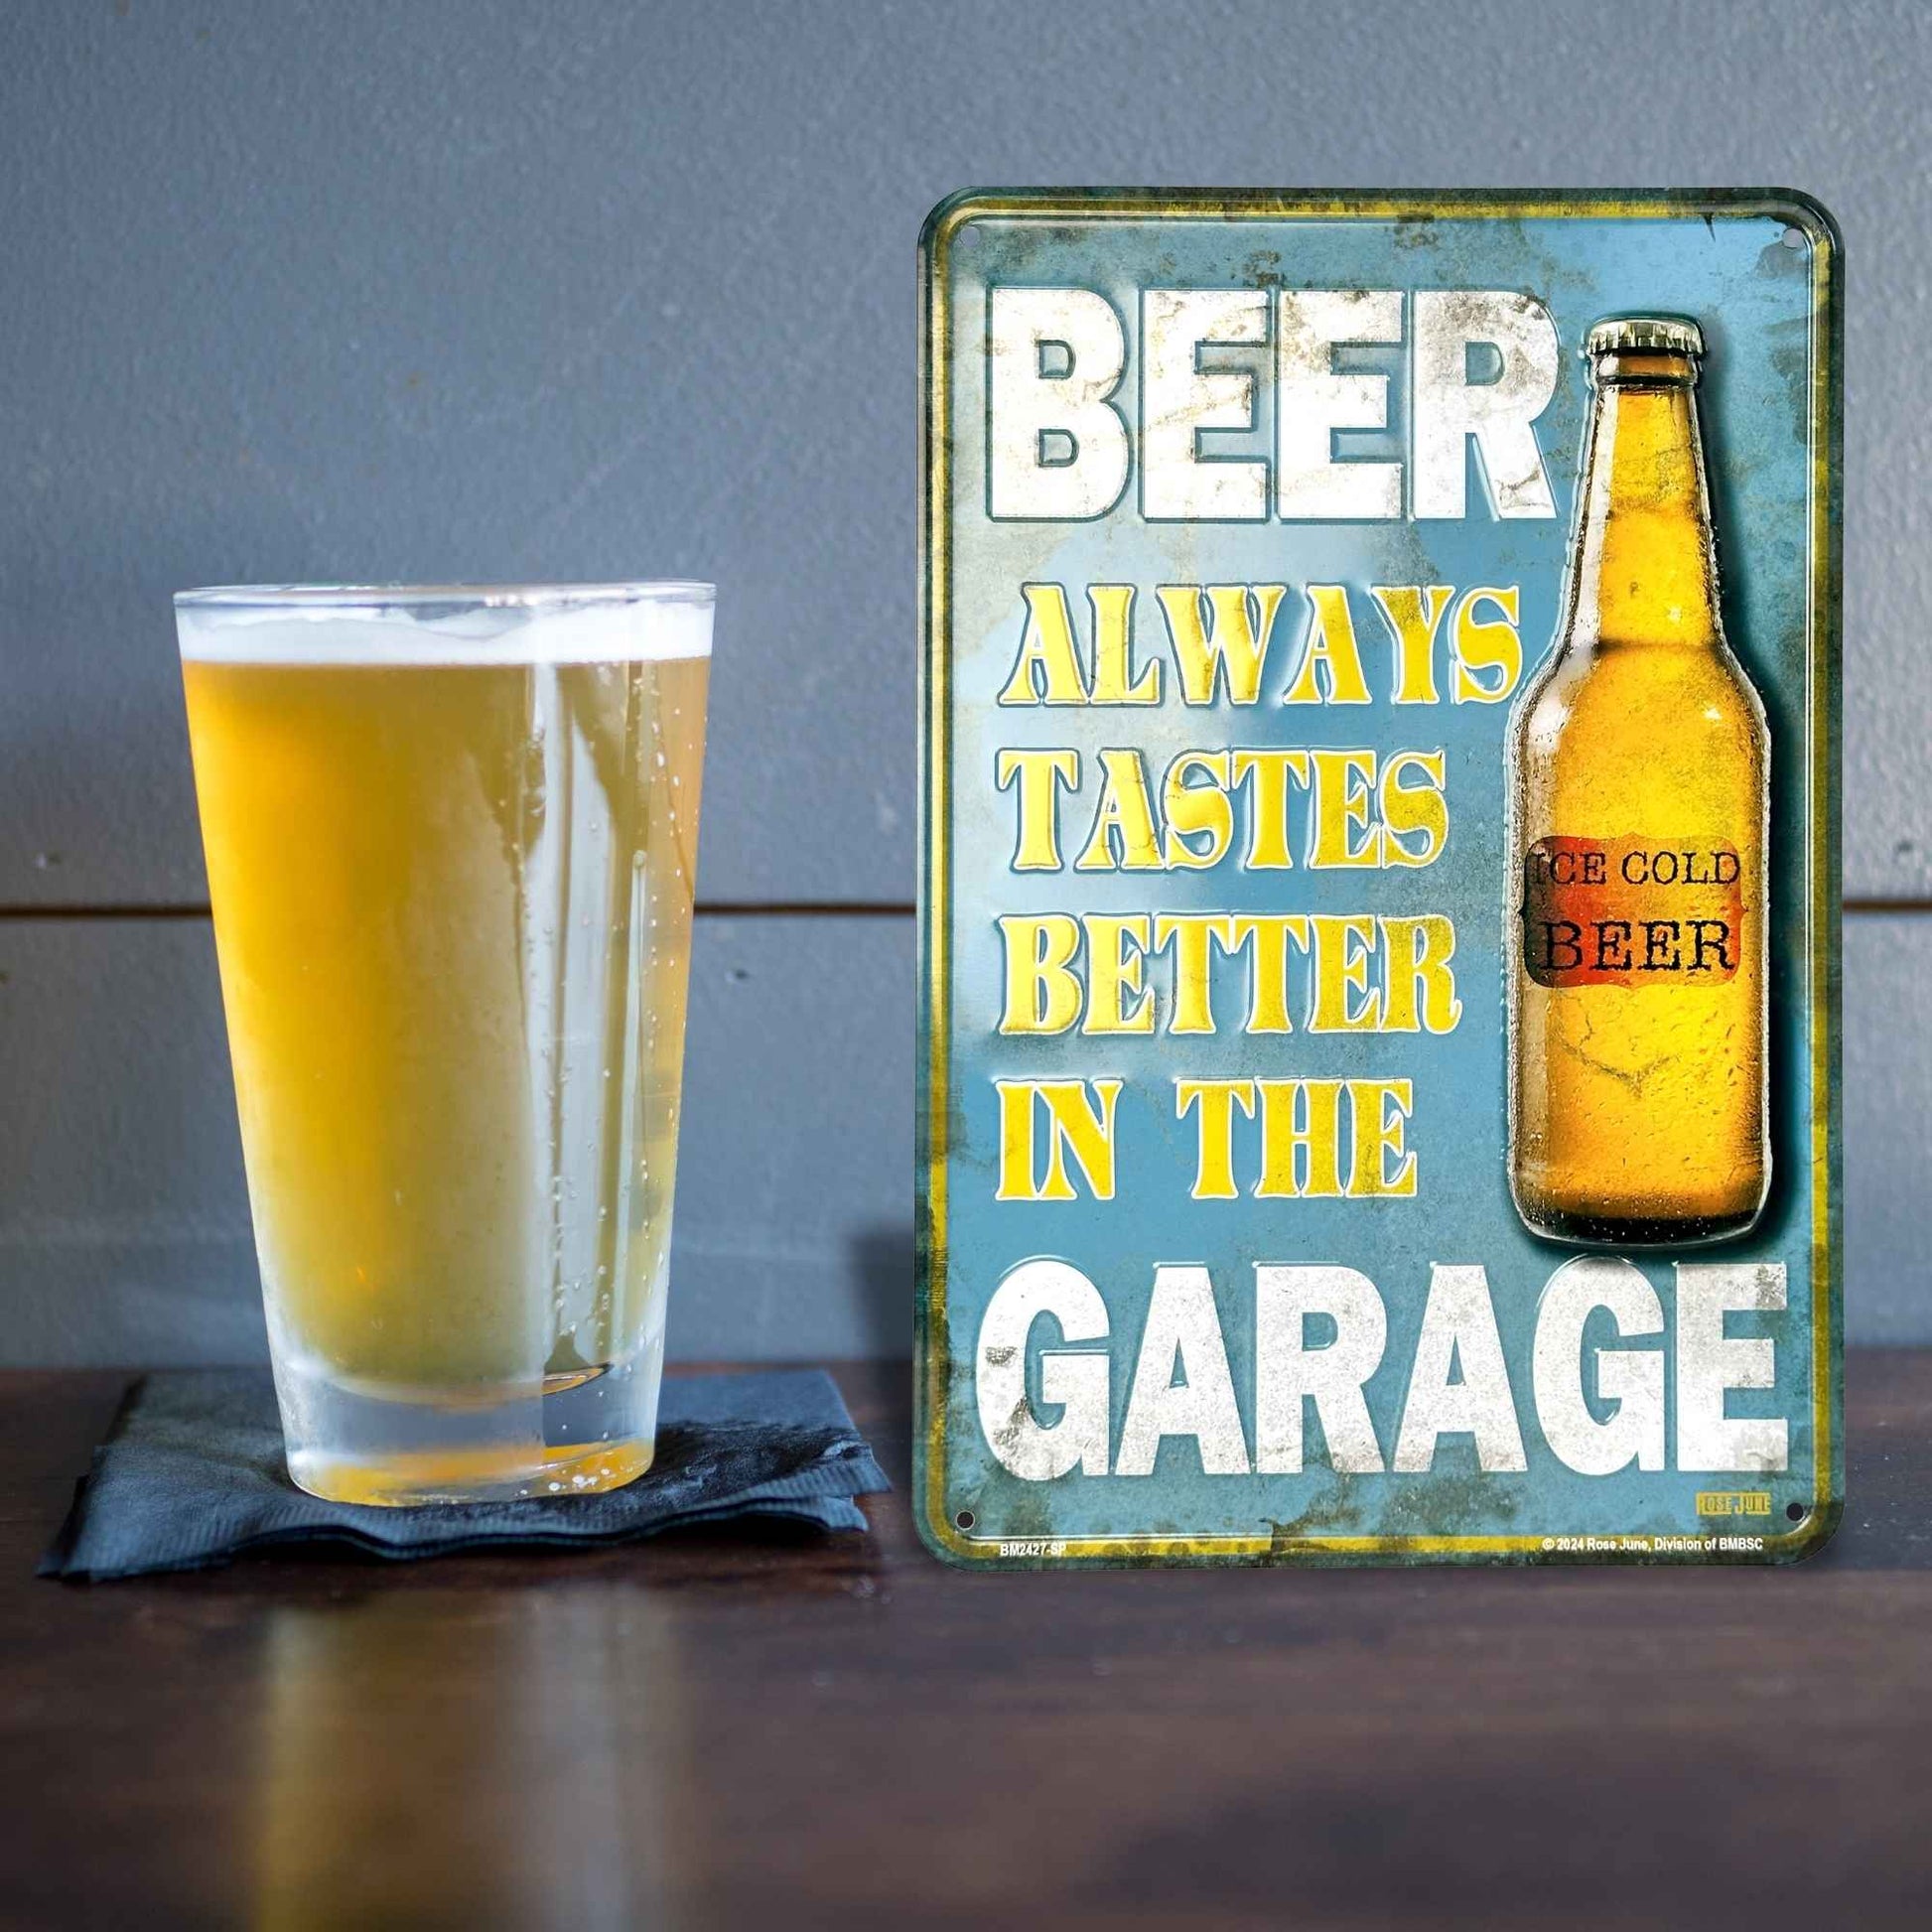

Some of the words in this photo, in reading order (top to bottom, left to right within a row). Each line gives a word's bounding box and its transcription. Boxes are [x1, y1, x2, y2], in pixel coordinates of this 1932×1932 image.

[989, 287, 1562, 521] BEER
[997, 582, 1523, 708] ALWAYS
[996, 747, 1449, 874] TASTES
[1530, 851, 1606, 886] ICE
[1621, 851, 1741, 886] COLD
[996, 912, 1464, 1035] BETTER
[1538, 919, 1735, 972] BEER
[994, 1079, 1122, 1202] IN
[1176, 1079, 1420, 1201] THE
[975, 1260, 1789, 1477] GARAGE
[999, 1542, 1067, 1558] BM2427-SP
[1557, 1538, 1585, 1551] 2024
[1587, 1538, 1617, 1551] Rose
[1619, 1538, 1652, 1552] June,
[1654, 1538, 1702, 1551] Division
[1704, 1538, 1717, 1551] of
[1719, 1538, 1763, 1551] BMBSC
